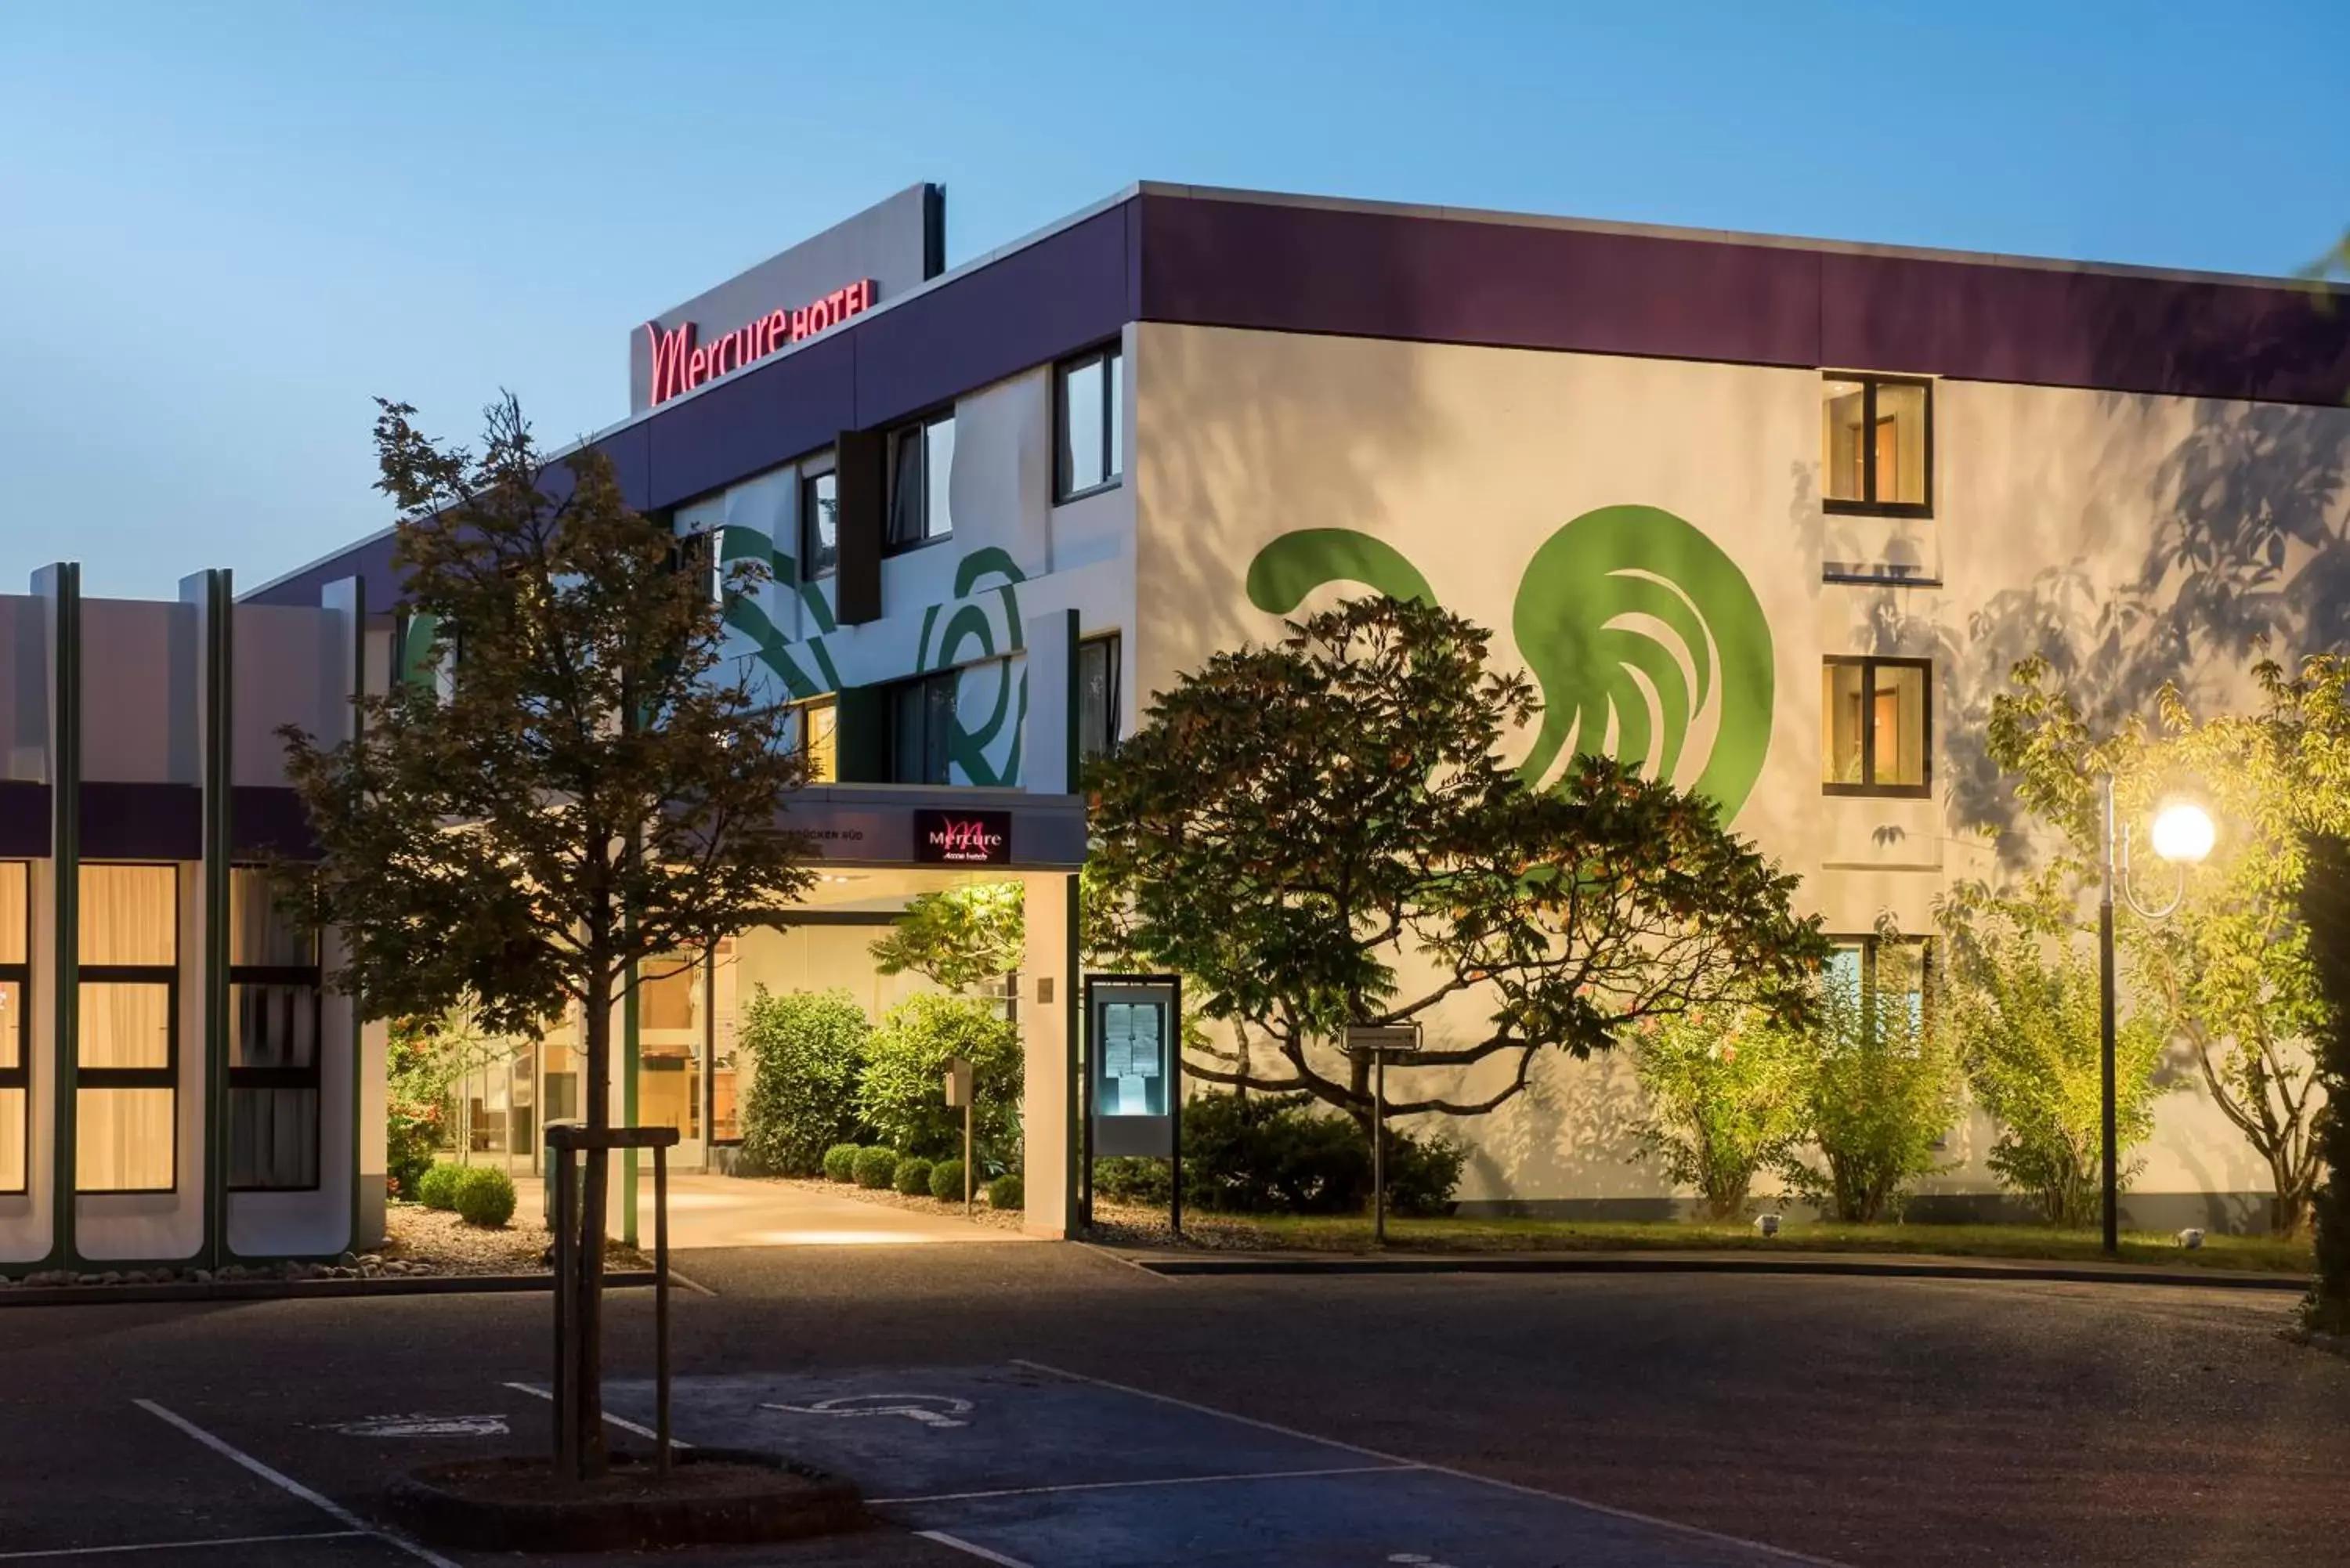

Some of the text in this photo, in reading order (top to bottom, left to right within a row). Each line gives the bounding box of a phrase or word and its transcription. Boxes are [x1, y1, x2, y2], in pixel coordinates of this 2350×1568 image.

[646, 277, 873, 406] Mercure HOTEL
[930, 832, 1002, 846] Mercure
